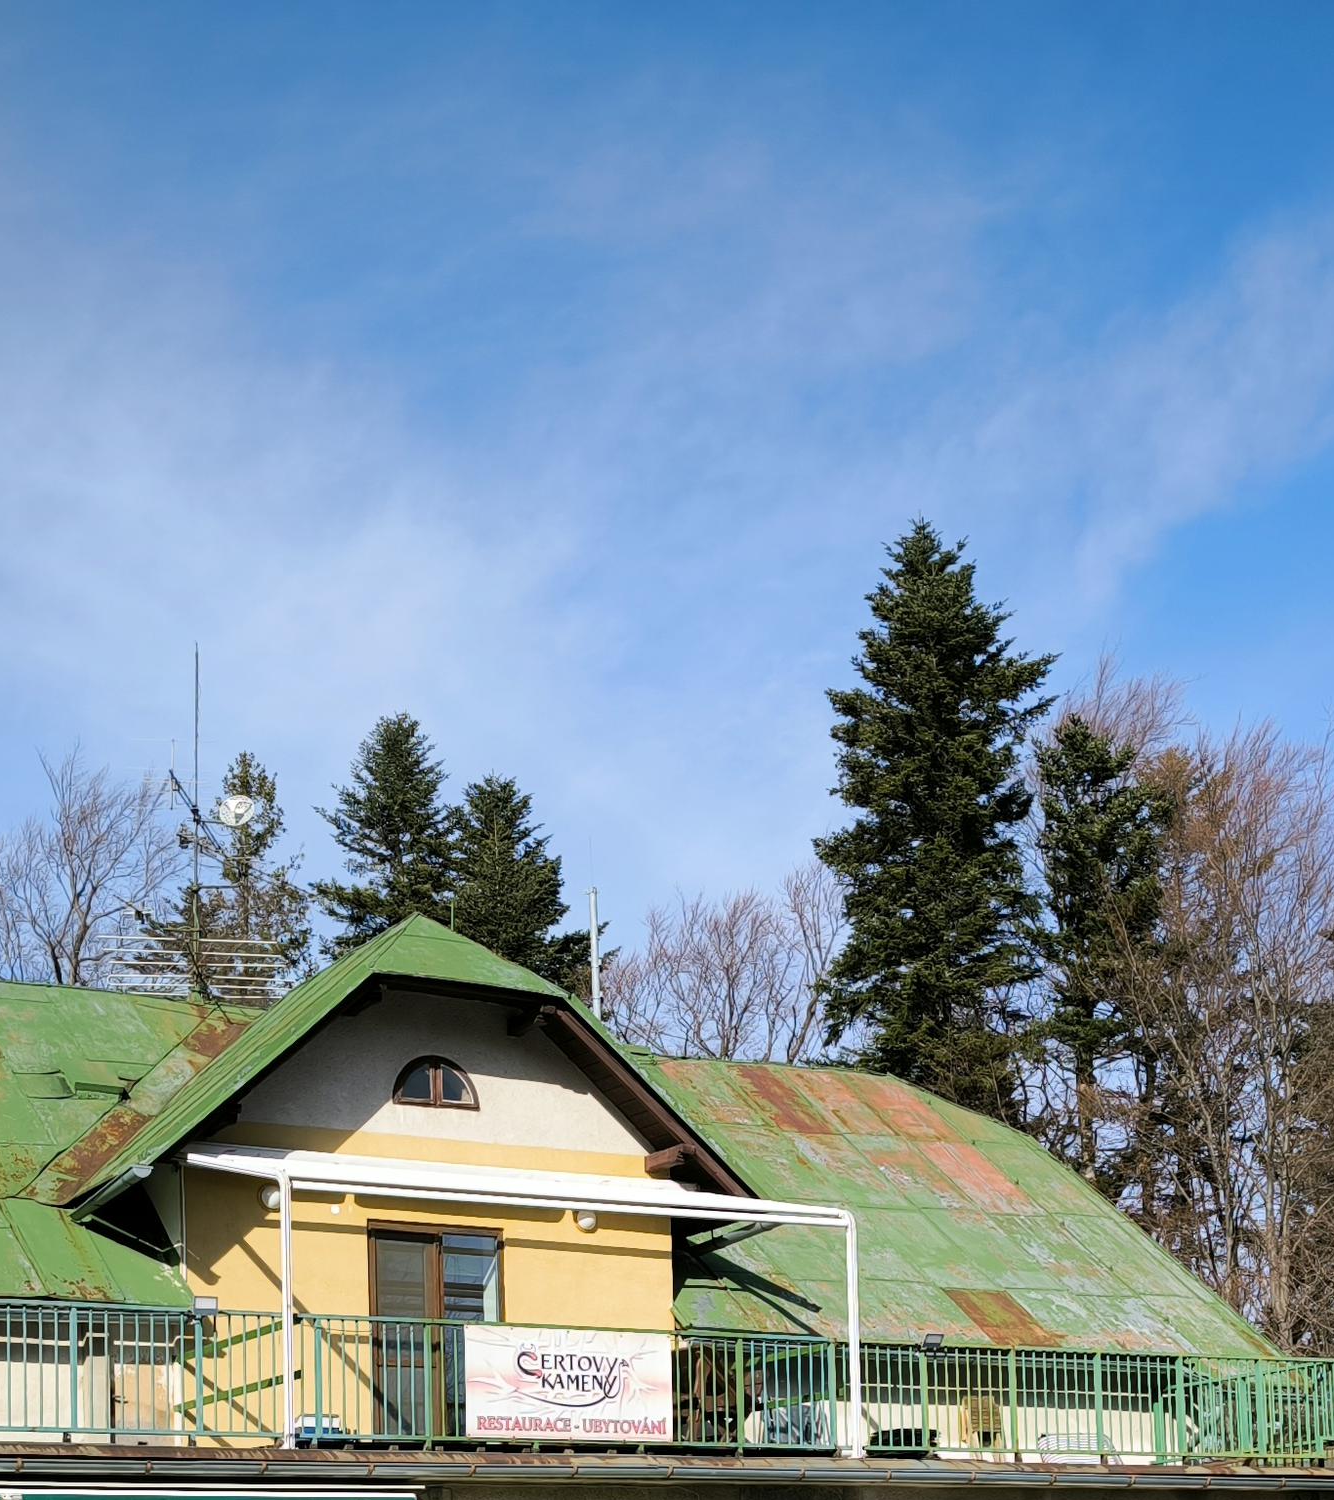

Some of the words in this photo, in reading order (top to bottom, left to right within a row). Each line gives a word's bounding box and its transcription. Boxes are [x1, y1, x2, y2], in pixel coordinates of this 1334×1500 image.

[541, 1373, 618, 1395] KAMENY
[476, 1415, 572, 1433] RESTAURACE
[581, 1416, 667, 1435] UBYTOVÁNÍ
